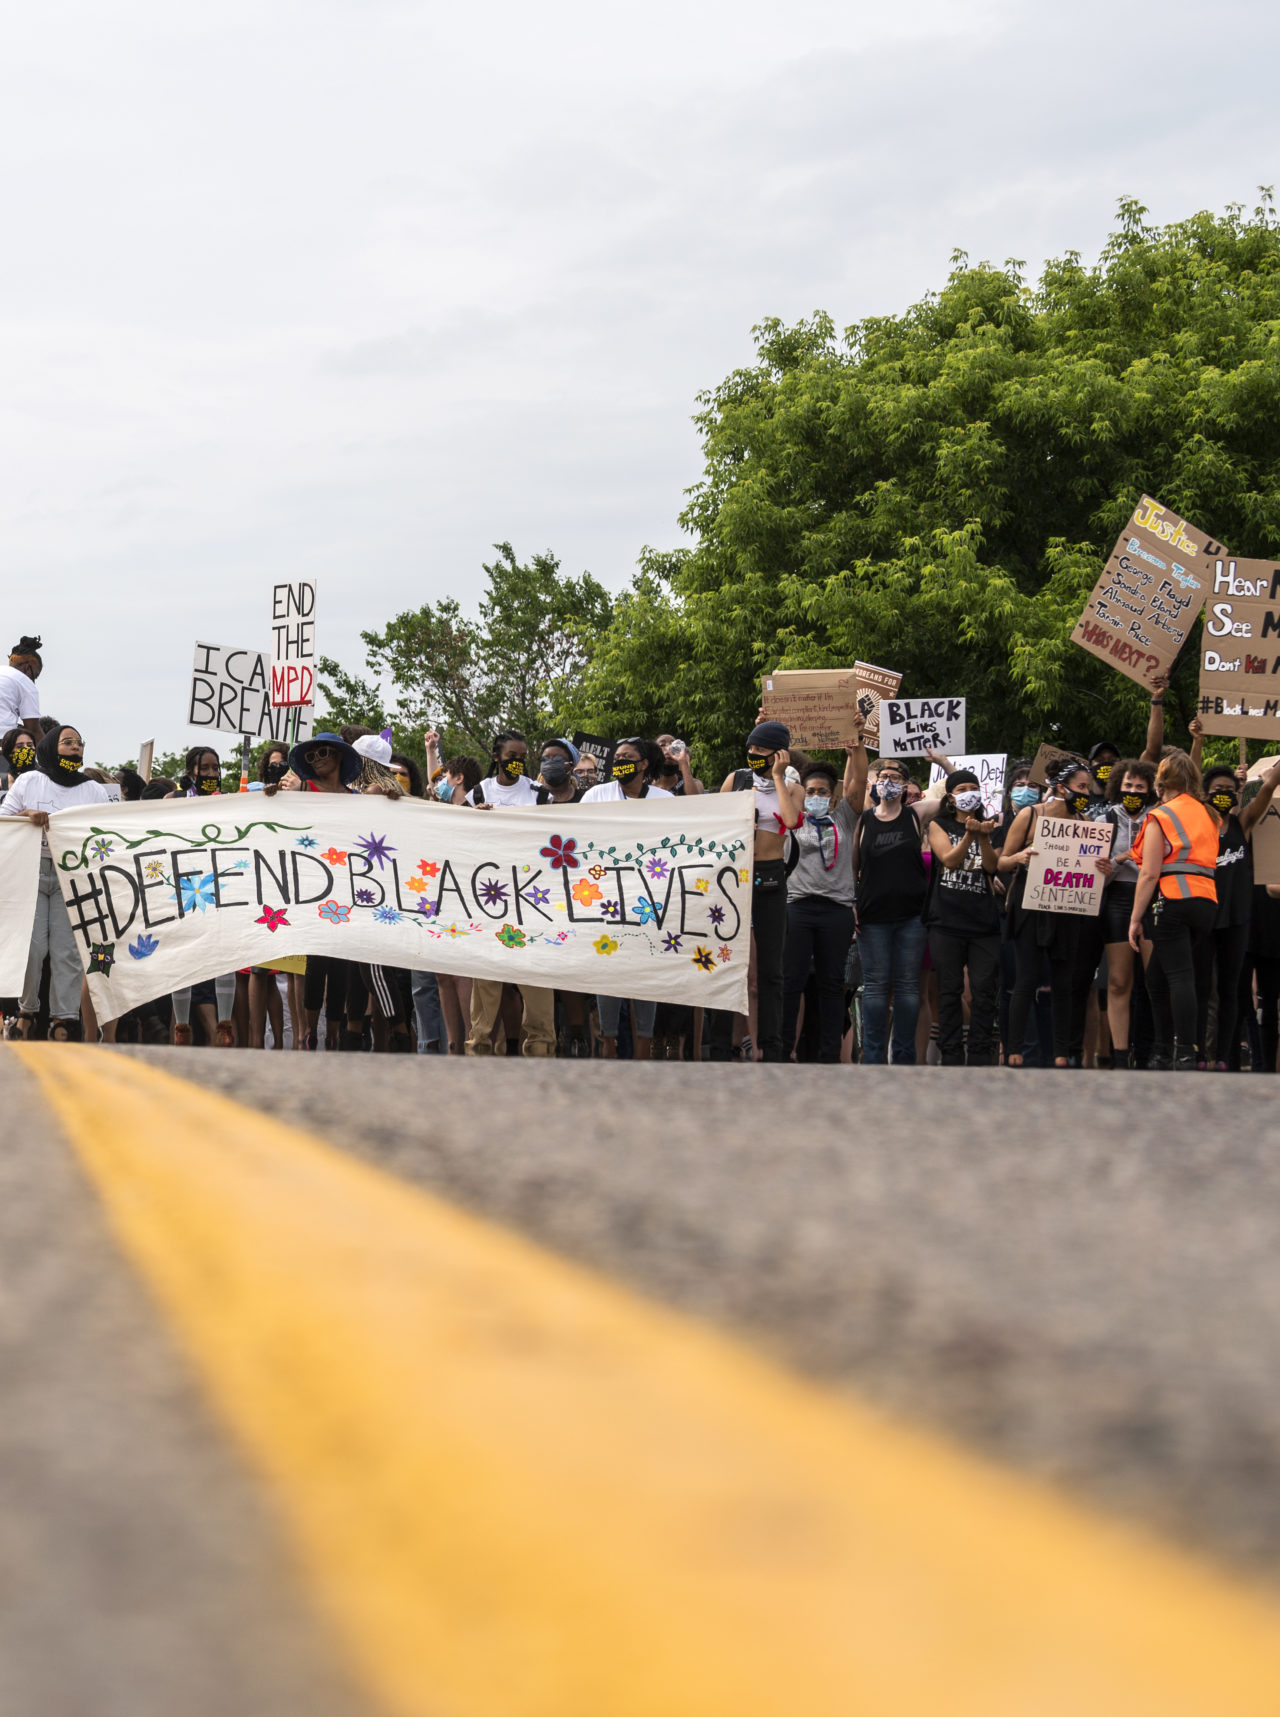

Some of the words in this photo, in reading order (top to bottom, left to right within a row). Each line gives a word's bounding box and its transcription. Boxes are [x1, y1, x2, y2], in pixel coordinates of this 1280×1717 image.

[1134, 498, 1199, 557] Justice
[1126, 538, 1167, 570] Breonna
[1172, 563, 1201, 589] Taylor
[1213, 560, 1268, 597] Hear
[1111, 572, 1147, 602] Sandra
[1150, 595, 1180, 620] Bland
[1118, 555, 1155, 586] George
[1158, 579, 1193, 611] Floyd
[272, 582, 315, 619] END
[1102, 586, 1146, 617] Ahmaud
[1147, 612, 1185, 643] Arbery
[1094, 600, 1124, 629] Tamir
[1127, 620, 1152, 647] Rice
[1207, 602, 1253, 638] See
[272, 621, 315, 661] THE
[194, 644, 221, 676] I
[1244, 654, 1268, 675] Kill
[272, 665, 313, 705] MPD
[855, 668, 883, 682] KOREANS
[883, 677, 897, 687] FOR
[887, 699, 962, 726] BLACK
[580, 741, 610, 758] MELT
[875, 832, 903, 846] NIKE
[1041, 819, 1112, 843] BLACKNESS
[1043, 842, 1070, 852] SHOULD
[1079, 844, 1104, 855] NOT
[1056, 857, 1070, 868] BE
[1074, 859, 1082, 867] A
[1043, 868, 1095, 888] DEATH
[1030, 885, 1097, 906] SENTENCE
